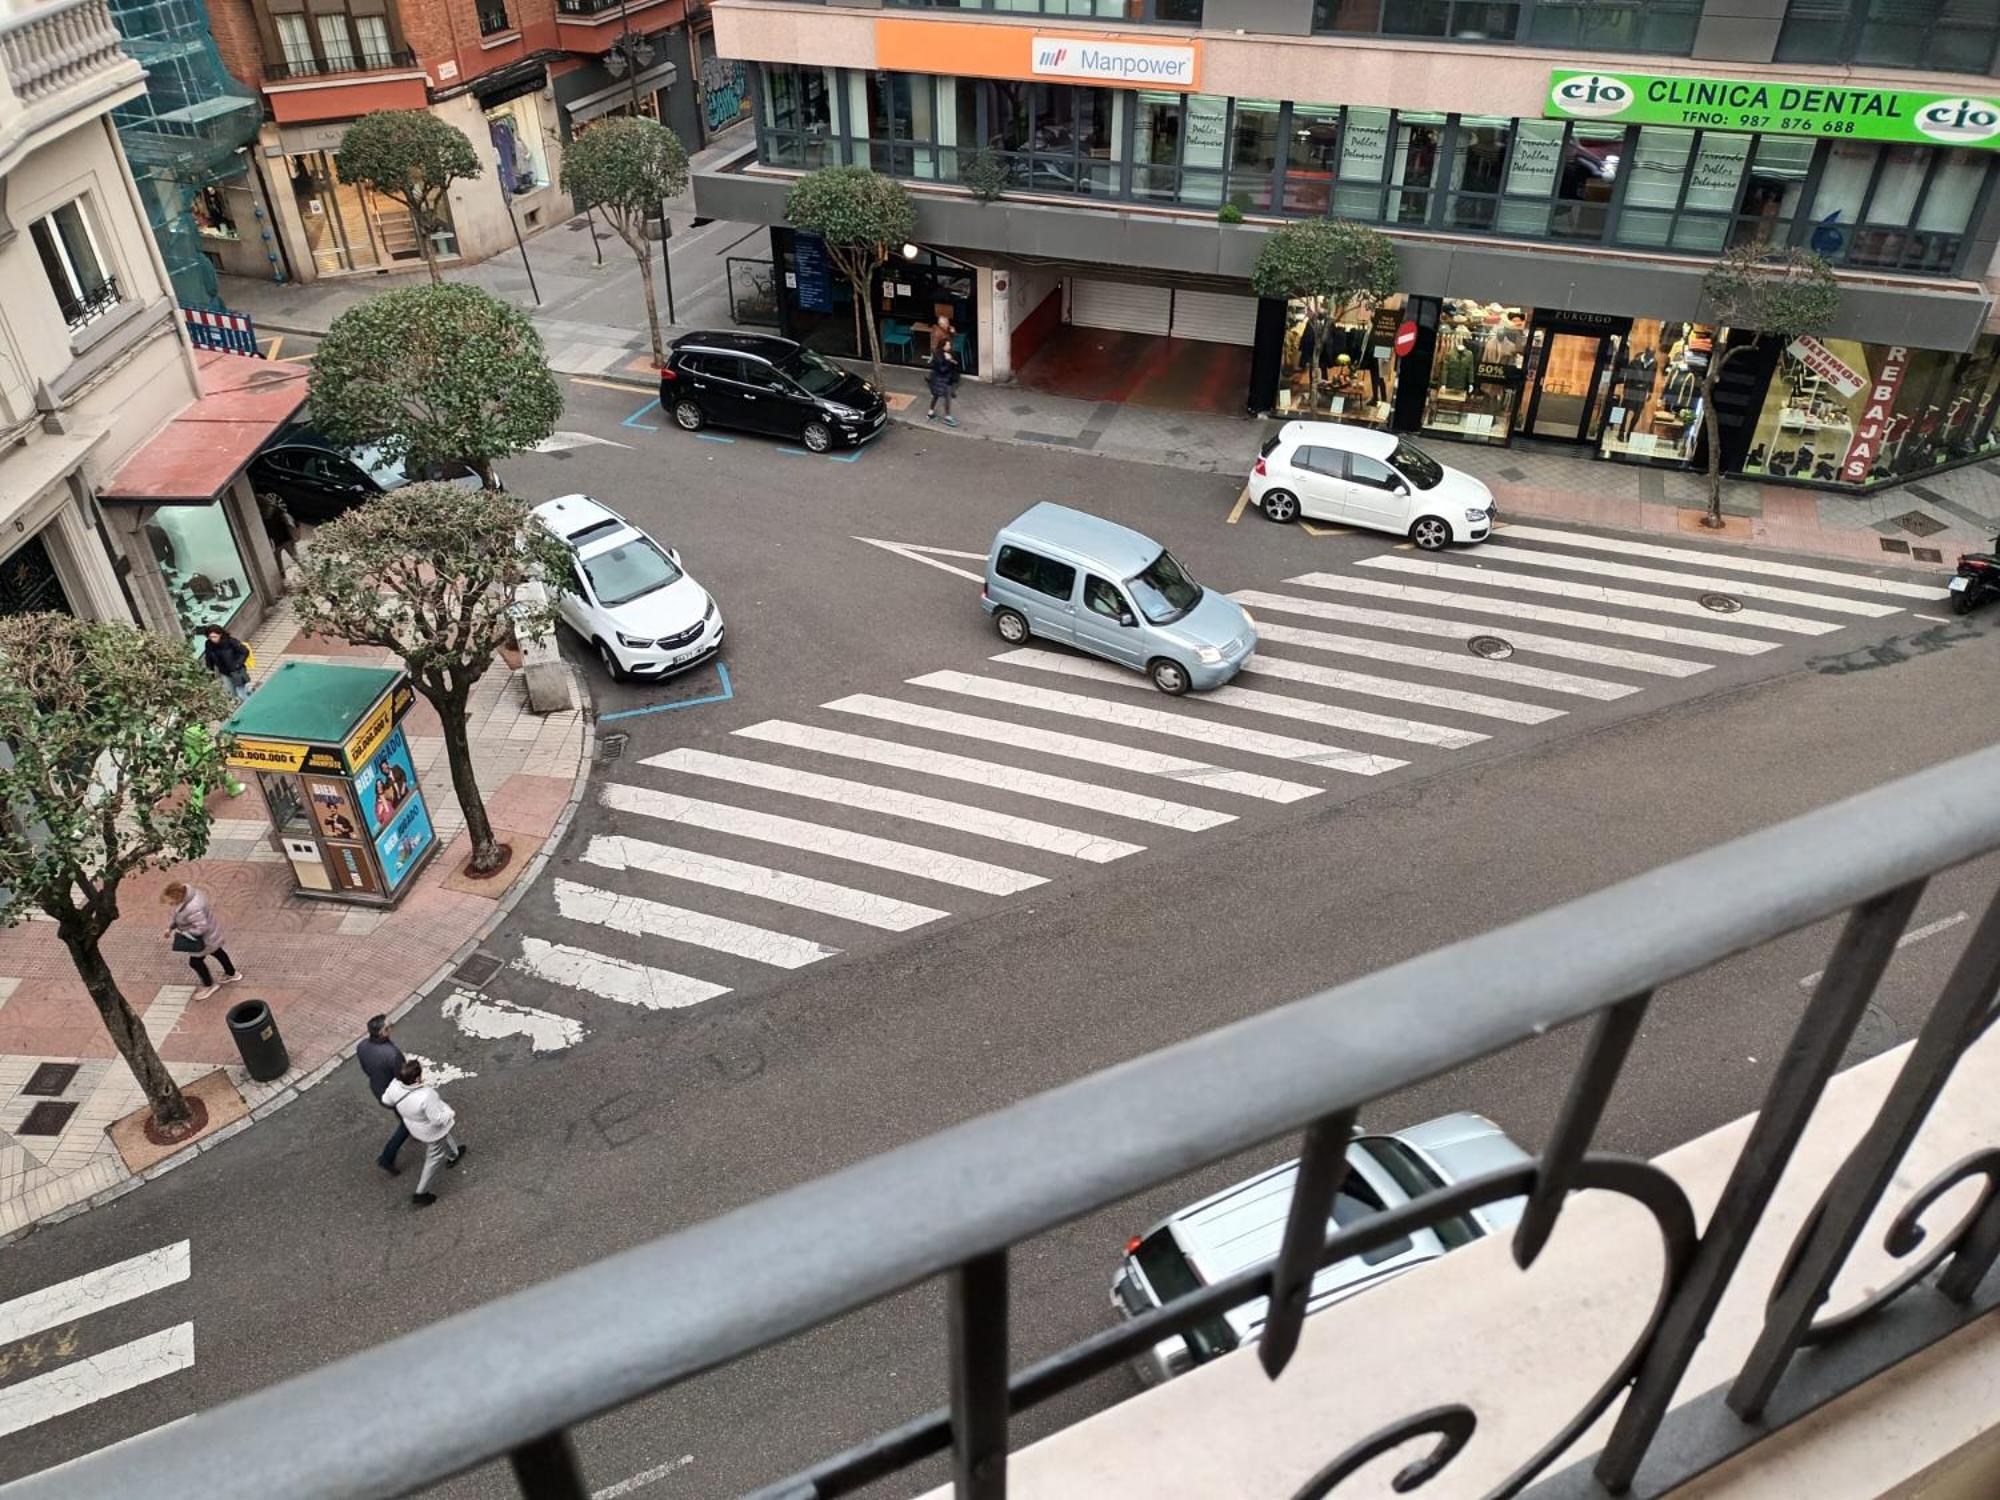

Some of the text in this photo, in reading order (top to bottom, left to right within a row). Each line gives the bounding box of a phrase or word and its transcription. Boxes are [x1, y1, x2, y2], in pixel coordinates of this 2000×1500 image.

[1081, 49, 1187, 77] Manpower
[1647, 80, 1903, 118] CLINICA DENTAL
[1682, 111, 1855, 133] TFNO: 987 876 688
[1847, 346, 1907, 476] REBAJAS
